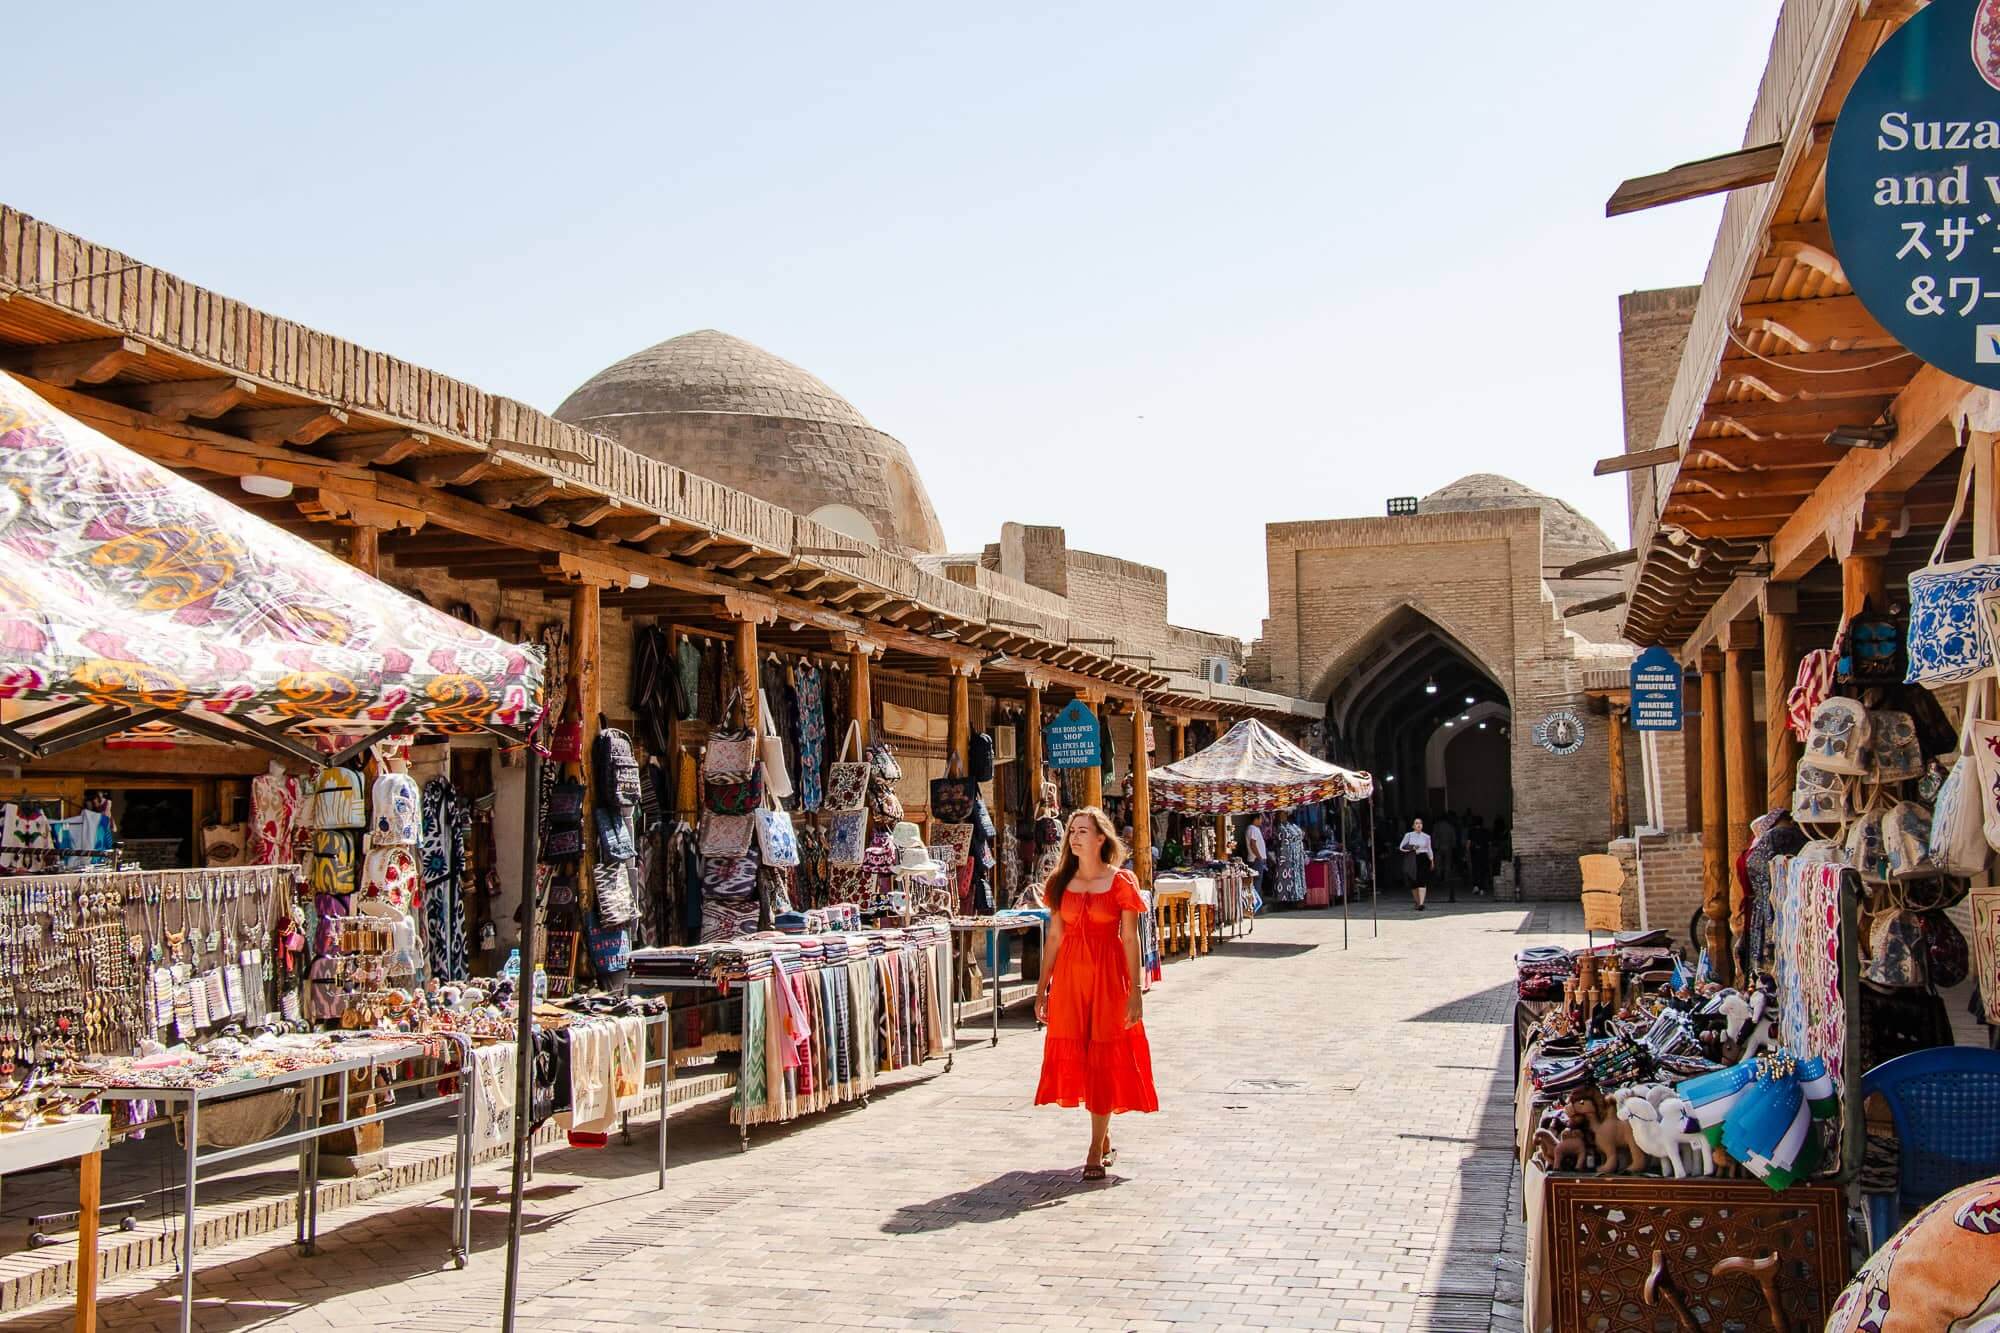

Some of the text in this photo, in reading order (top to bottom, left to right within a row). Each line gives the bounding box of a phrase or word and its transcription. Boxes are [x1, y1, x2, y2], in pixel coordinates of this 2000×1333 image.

[1873, 165, 1970, 206] and
[1895, 213, 2000, 262] スザ
[1665, 674, 1674, 682] DE
